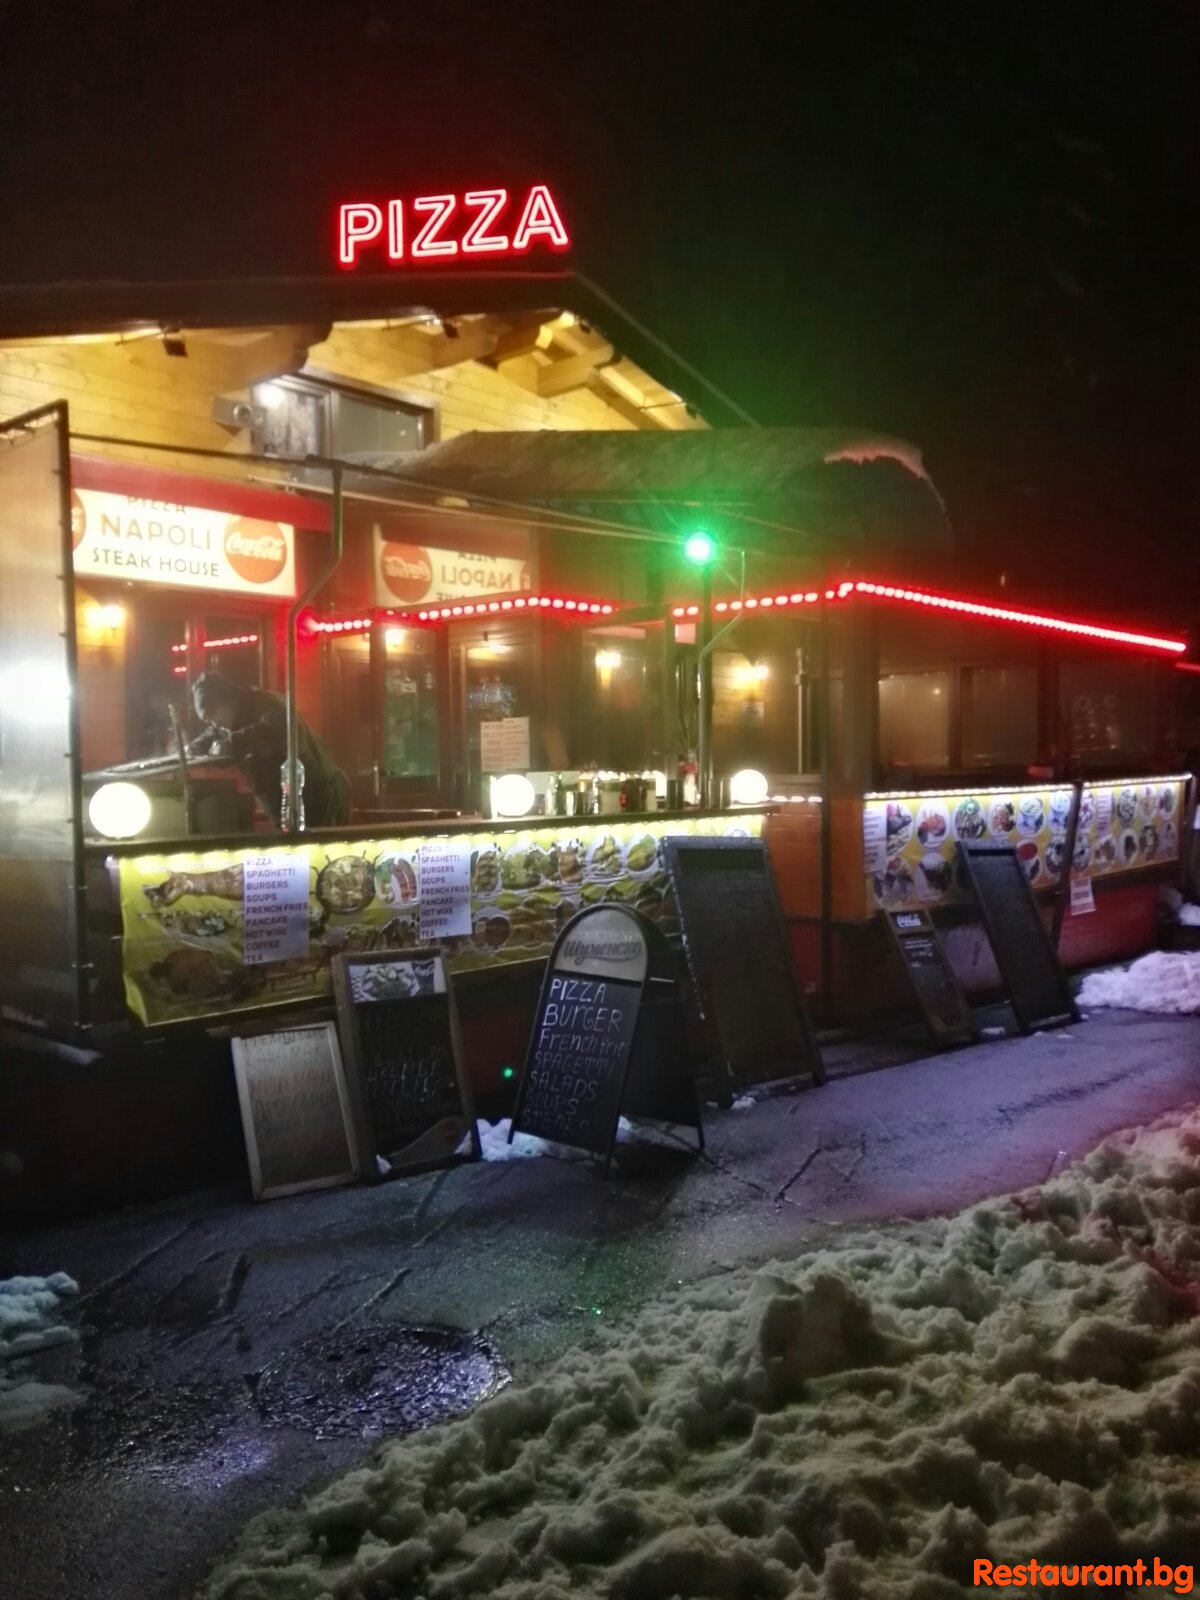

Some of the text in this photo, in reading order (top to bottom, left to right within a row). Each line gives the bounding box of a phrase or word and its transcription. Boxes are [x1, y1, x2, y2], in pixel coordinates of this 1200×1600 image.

[340, 185, 568, 262] PIZZA
[99, 512, 211, 550] NAPOLI
[92, 547, 220, 577] STEAK HOUSE
[246, 857, 273, 866] PIZZA
[422, 855, 460, 864] SPAGHETTI
[246, 868, 296, 879] SPAGHETTI
[421, 866, 455, 875] BURGERS
[246, 881, 289, 891] BURGERS
[421, 877, 446, 885] SOUPS
[421, 885, 470, 895] FRENCH FRIES
[246, 893, 277, 903] SOUPS
[421, 898, 454, 906] PANCAKE
[246, 903, 308, 914] FRENCH FRIES
[246, 916, 288, 927] PANCAKE
[421, 918, 448, 928] COFFEE
[246, 930, 263, 939] HOT
[421, 930, 435, 938] TEA
[245, 940, 280, 951] COFFEE
[246, 954, 263, 964] TEA
[549, 978, 607, 1004] PIZZA
[528, 1070, 599, 1102] SALADS
[526, 1089, 580, 1116] SOUPS
